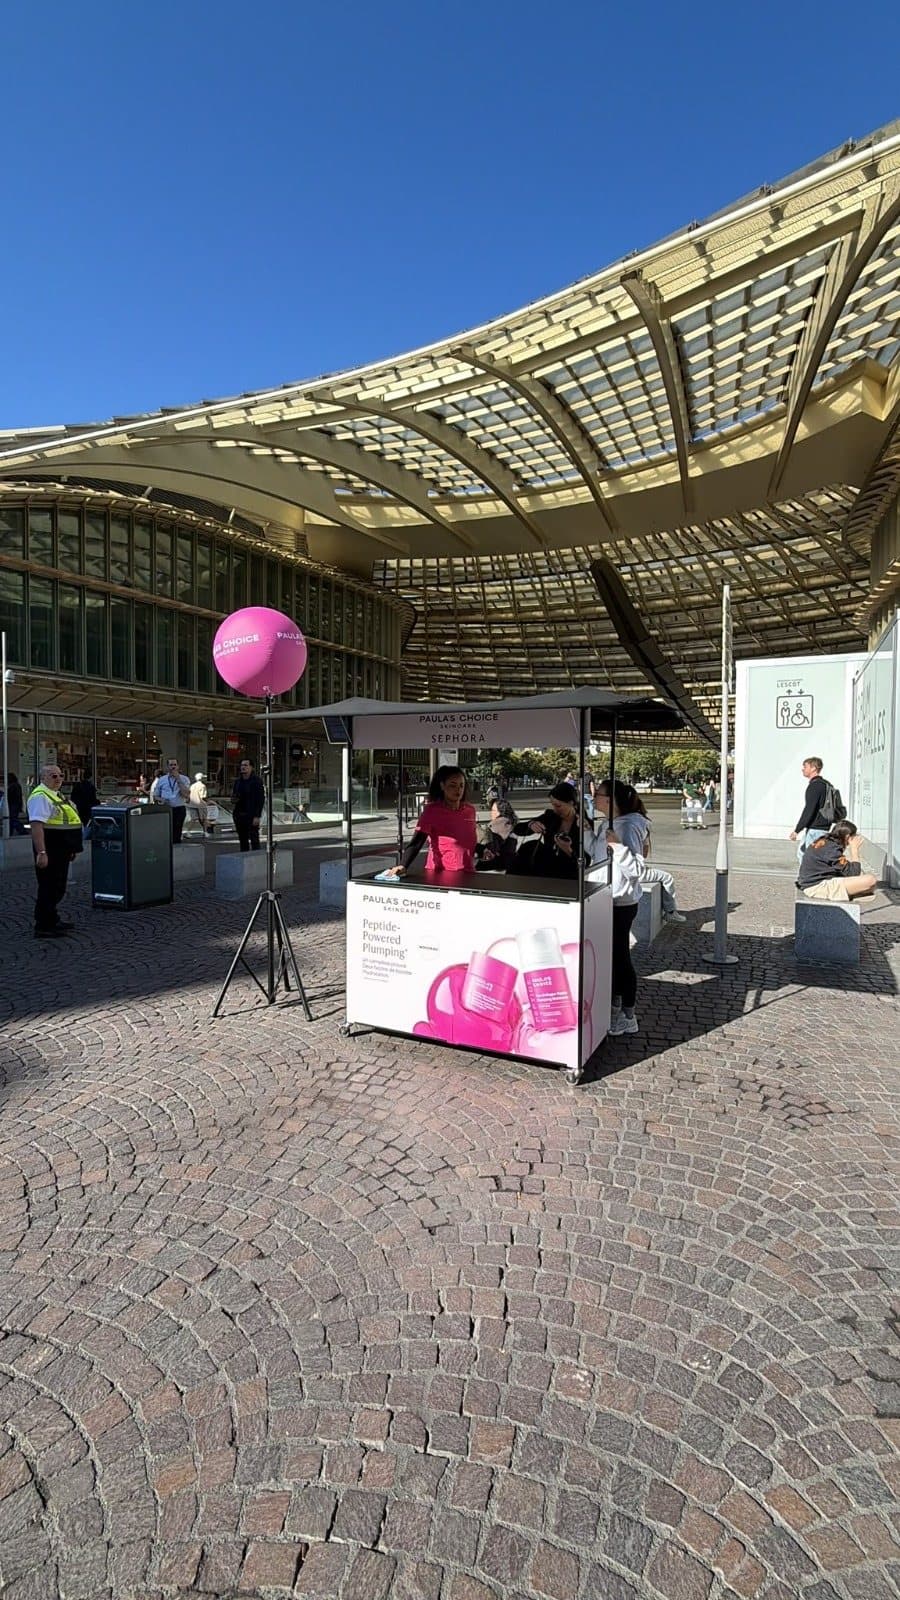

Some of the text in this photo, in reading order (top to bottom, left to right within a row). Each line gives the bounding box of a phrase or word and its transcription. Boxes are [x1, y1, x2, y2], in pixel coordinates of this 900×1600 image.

[223, 633, 260, 648] CHOICE
[276, 631, 304, 641] PAULA
[419, 713, 499, 723] PAULA'S CHOICE
[431, 733, 486, 744] SEPHORA
[362, 894, 441, 910] PAULA'S CHOICE
[383, 906, 419, 915] SKINCARE
[362, 918, 401, 932] Peptide-
[362, 930, 401, 945] Powered
